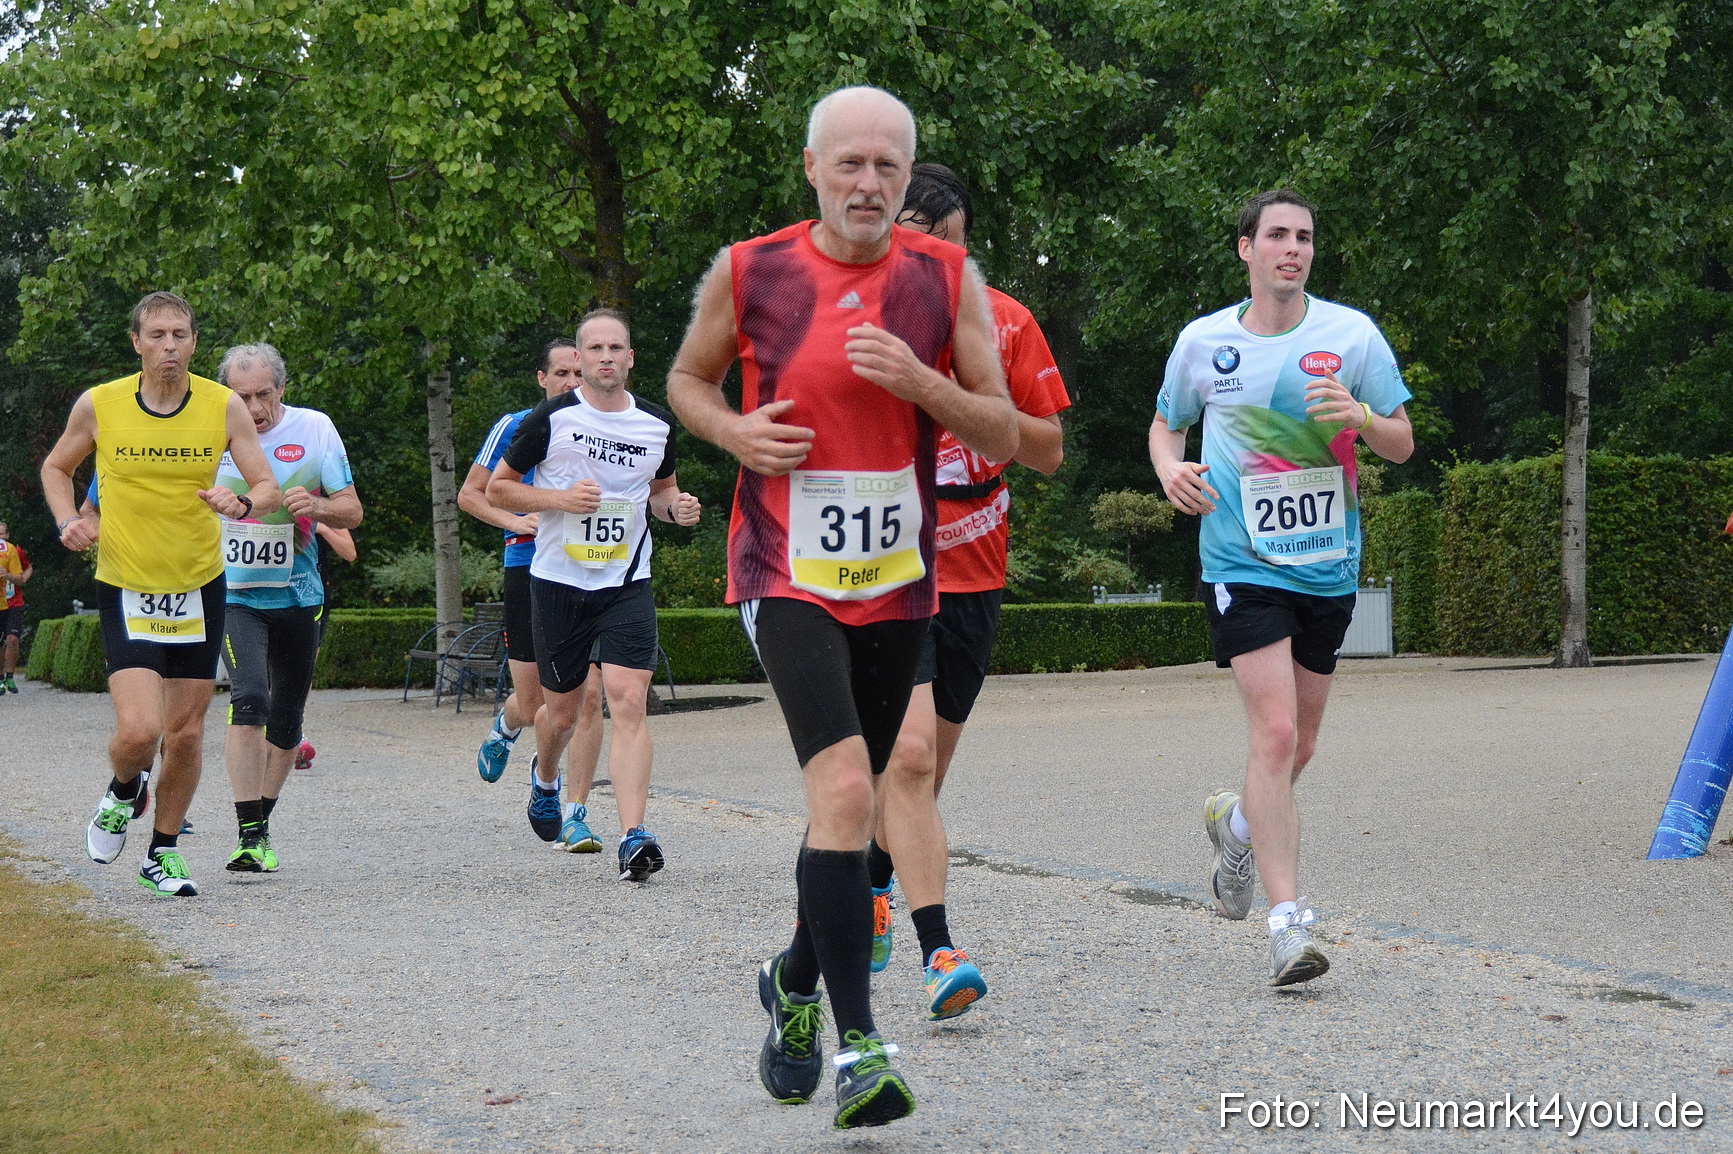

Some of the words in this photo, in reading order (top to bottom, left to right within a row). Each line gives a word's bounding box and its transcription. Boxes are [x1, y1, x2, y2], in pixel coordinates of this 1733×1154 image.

[1306, 358, 1338, 369] Hervis
[1214, 378, 1243, 388] PARTL
[1215, 386, 1243, 394] Neumarkt
[116, 446, 213, 458] KLINGELE
[585, 435, 647, 456] INTERSPORT
[279, 448, 302, 458] Hervis
[588, 447, 636, 468] HÄCKL
[1287, 471, 1335, 487] BOCK
[801, 486, 846, 495] NeuerMarkt
[1250, 484, 1282, 493] NeuerMarkt
[599, 502, 634, 511] BOCK
[1255, 490, 1336, 532] 2607
[252, 526, 288, 536] BOCK
[580, 516, 625, 543] 155
[820, 503, 901, 553] 315
[226, 538, 288, 565] 3049
[1265, 536, 1333, 554] Maximilian
[838, 567, 880, 585] Peter
[140, 592, 187, 617] 342
[150, 622, 178, 634] Klaus
